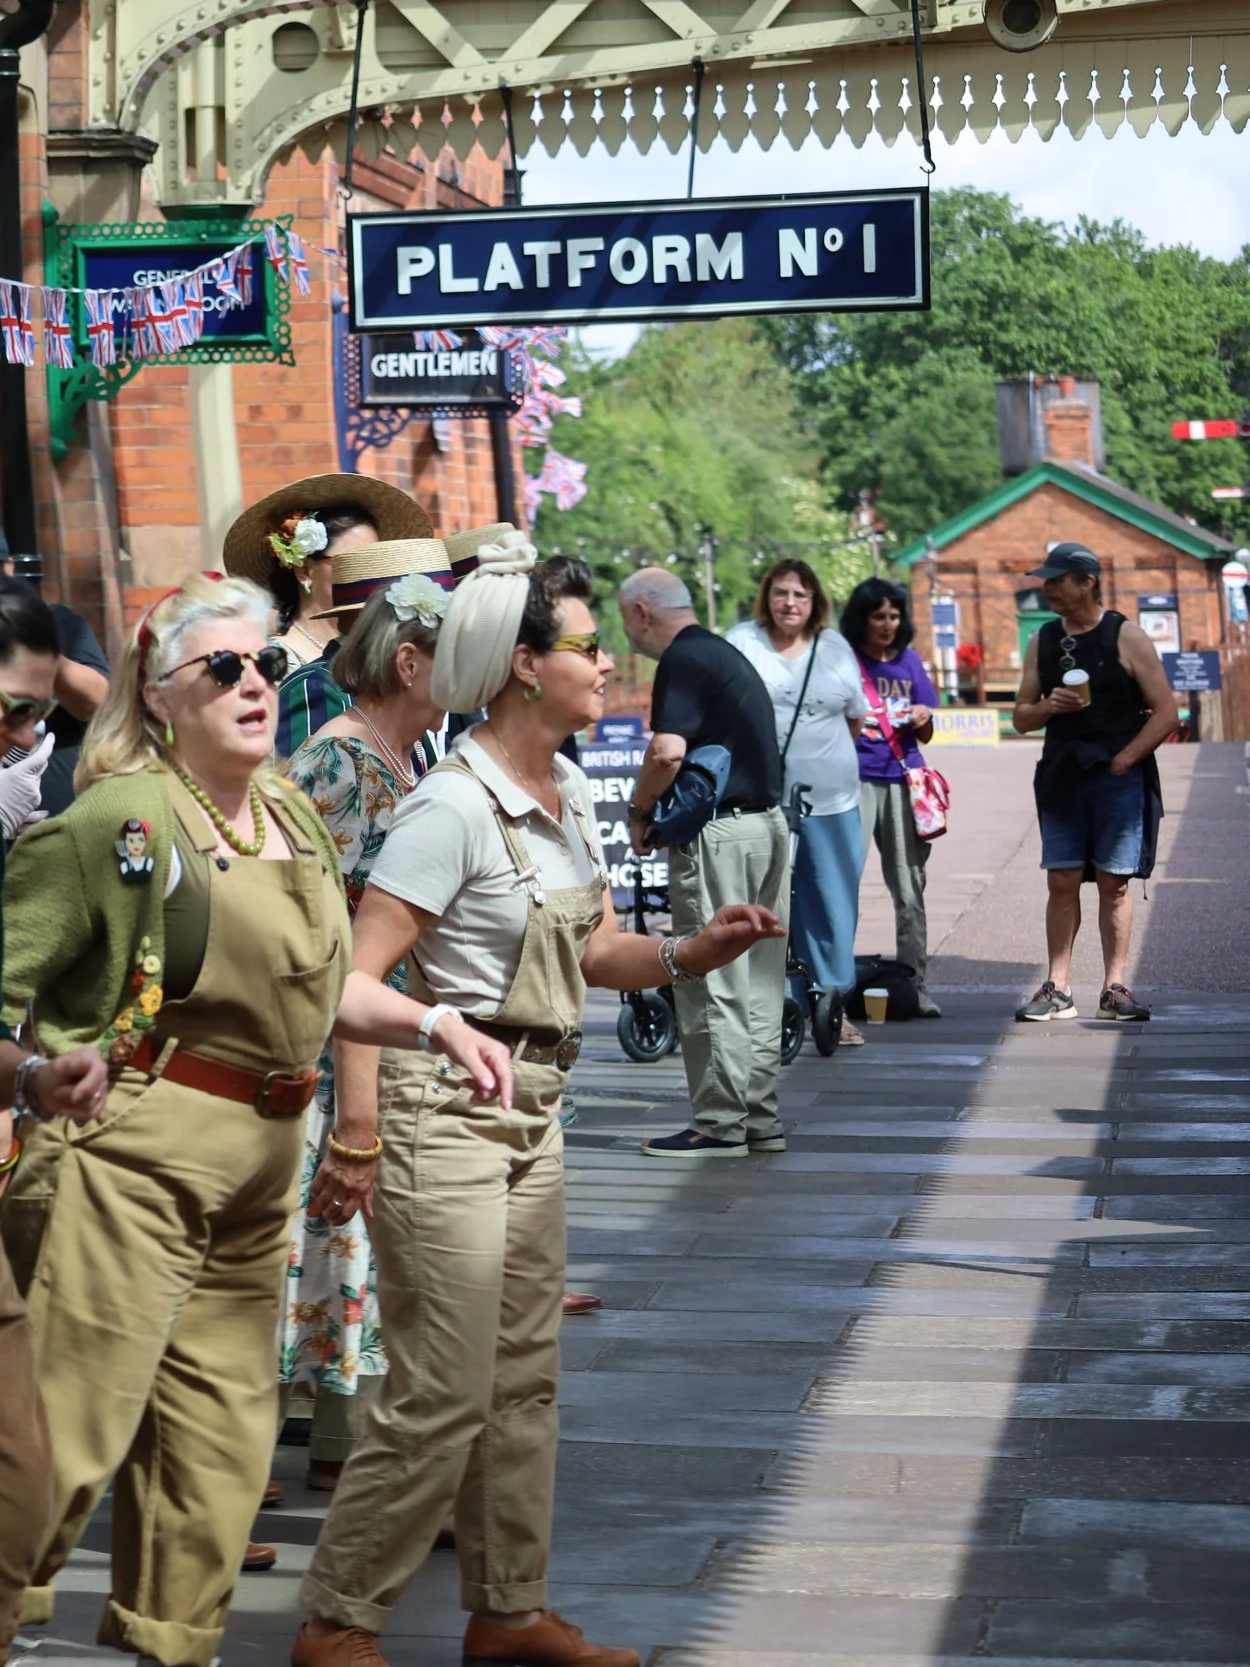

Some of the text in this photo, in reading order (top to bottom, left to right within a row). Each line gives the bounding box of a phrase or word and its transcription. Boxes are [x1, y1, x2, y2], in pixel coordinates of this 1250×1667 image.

[396, 231, 744, 295] PLATFORM
[133, 269, 214, 286] GENEL
[202, 296, 245, 313] OOM
[371, 350, 497, 378] GENTLEMEN
[877, 677, 912, 698] DAY
[581, 750, 631, 768] BRITISH
[591, 778, 635, 802] BEV
[598, 820, 631, 846] CA
